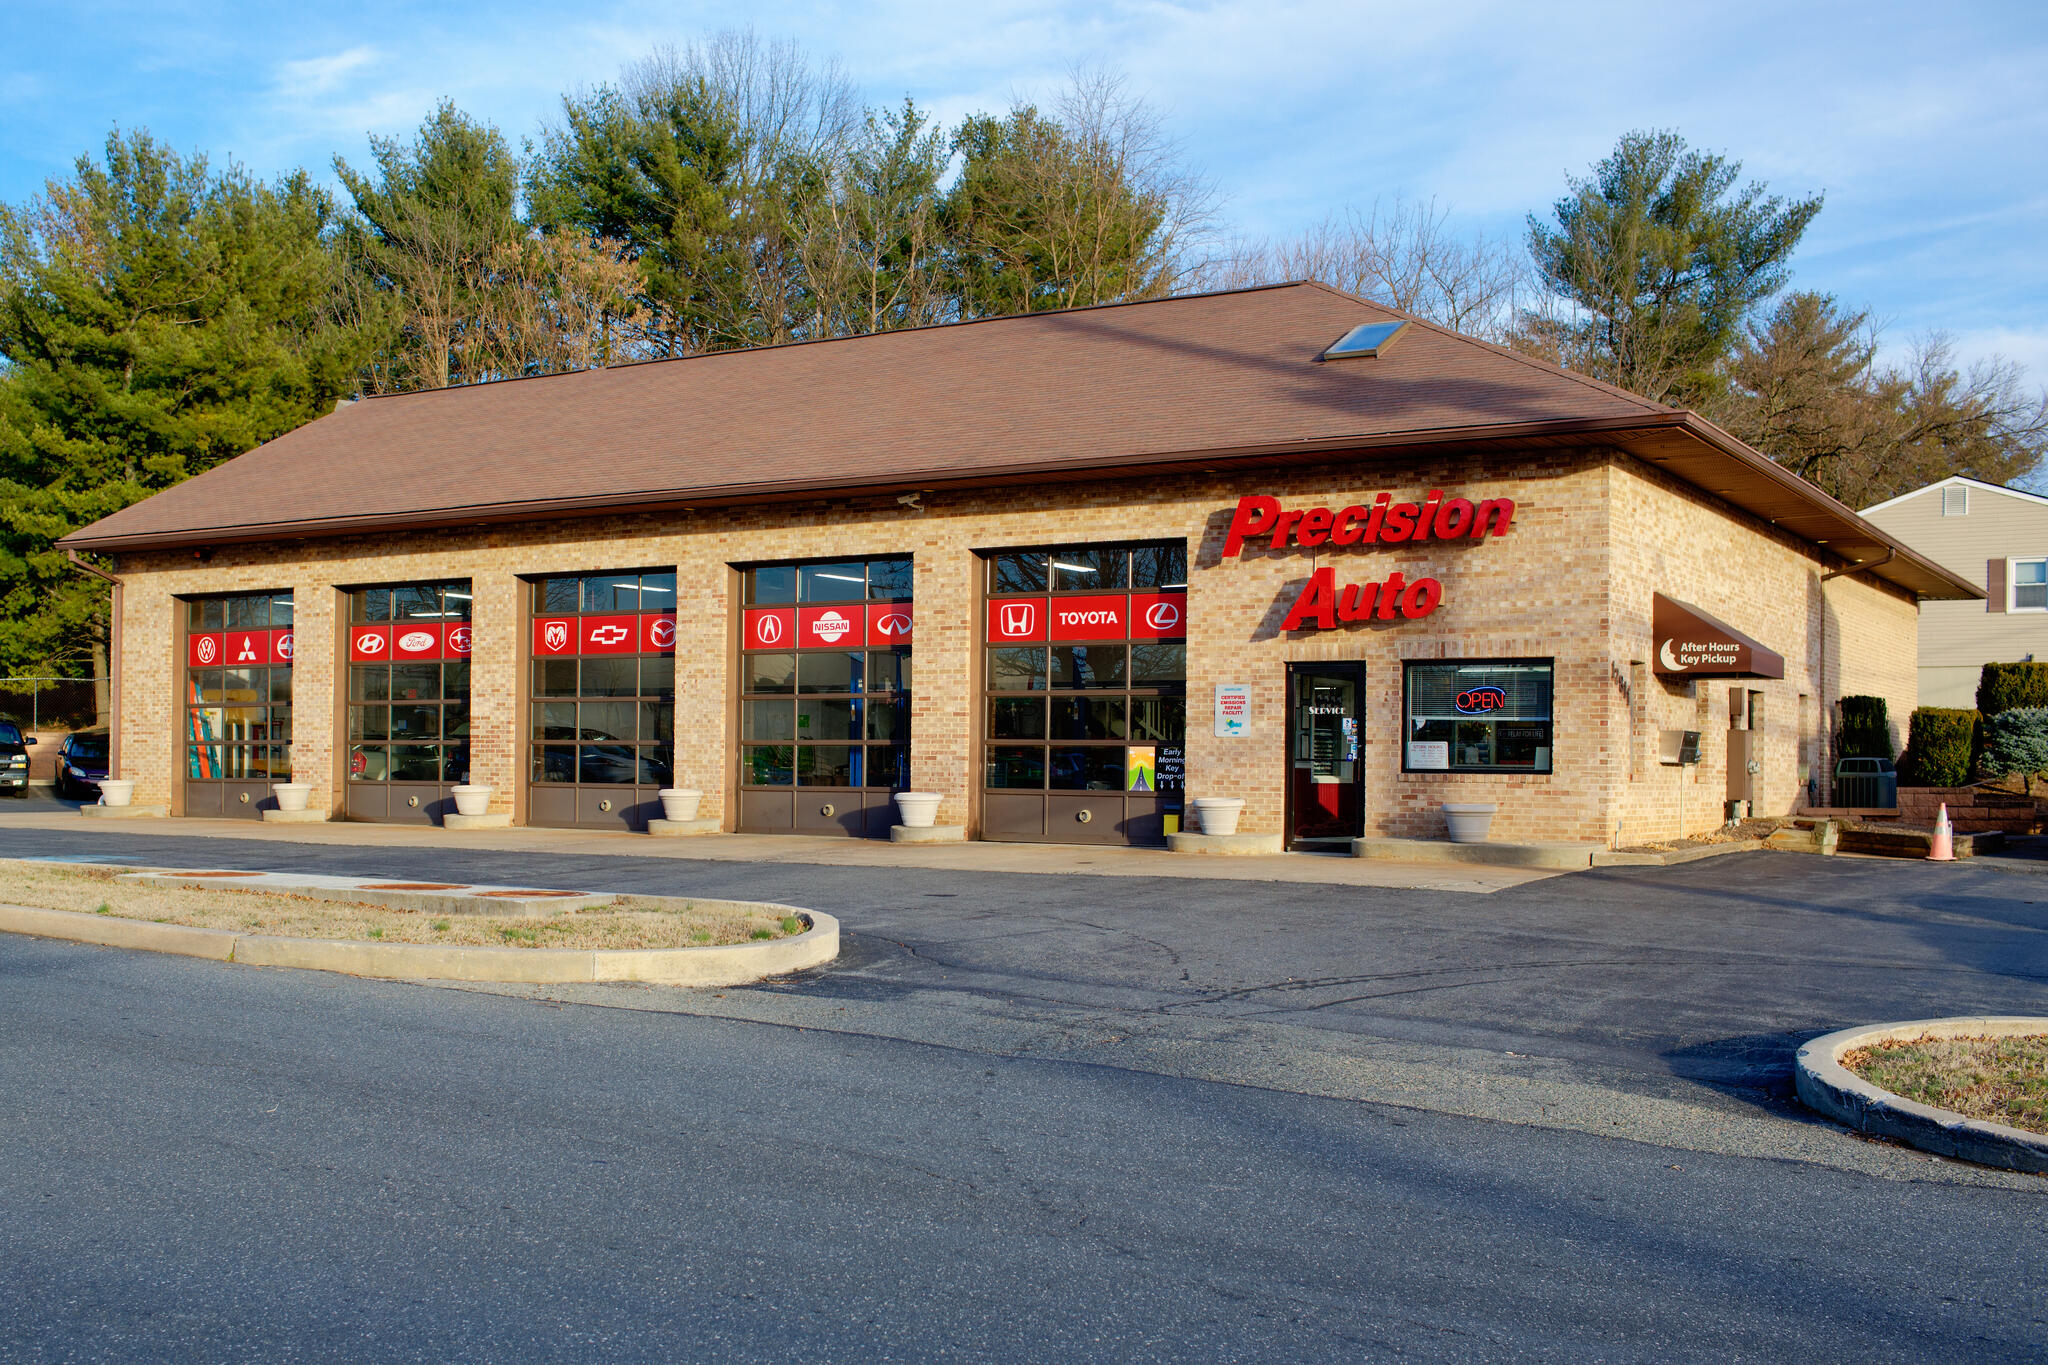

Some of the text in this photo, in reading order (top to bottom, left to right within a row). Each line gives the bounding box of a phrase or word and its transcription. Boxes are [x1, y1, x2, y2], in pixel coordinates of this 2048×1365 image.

[1222, 489, 1515, 558] Precision
[1279, 567, 1442, 630] Auto
[1059, 611, 1118, 625] TOYOTA
[814, 622, 848, 631] NISSAN
[406, 636, 427, 647] Ford
[1680, 642, 1740, 652] After Hours
[1680, 653, 1736, 666] Key Pickup
[1456, 692, 1504, 708] OPEN
[1163, 748, 1181, 756] Early
[1158, 756, 1185, 764] Morning
[1165, 765, 1179, 773] Key
[1157, 773, 1185, 781] Drop-of
